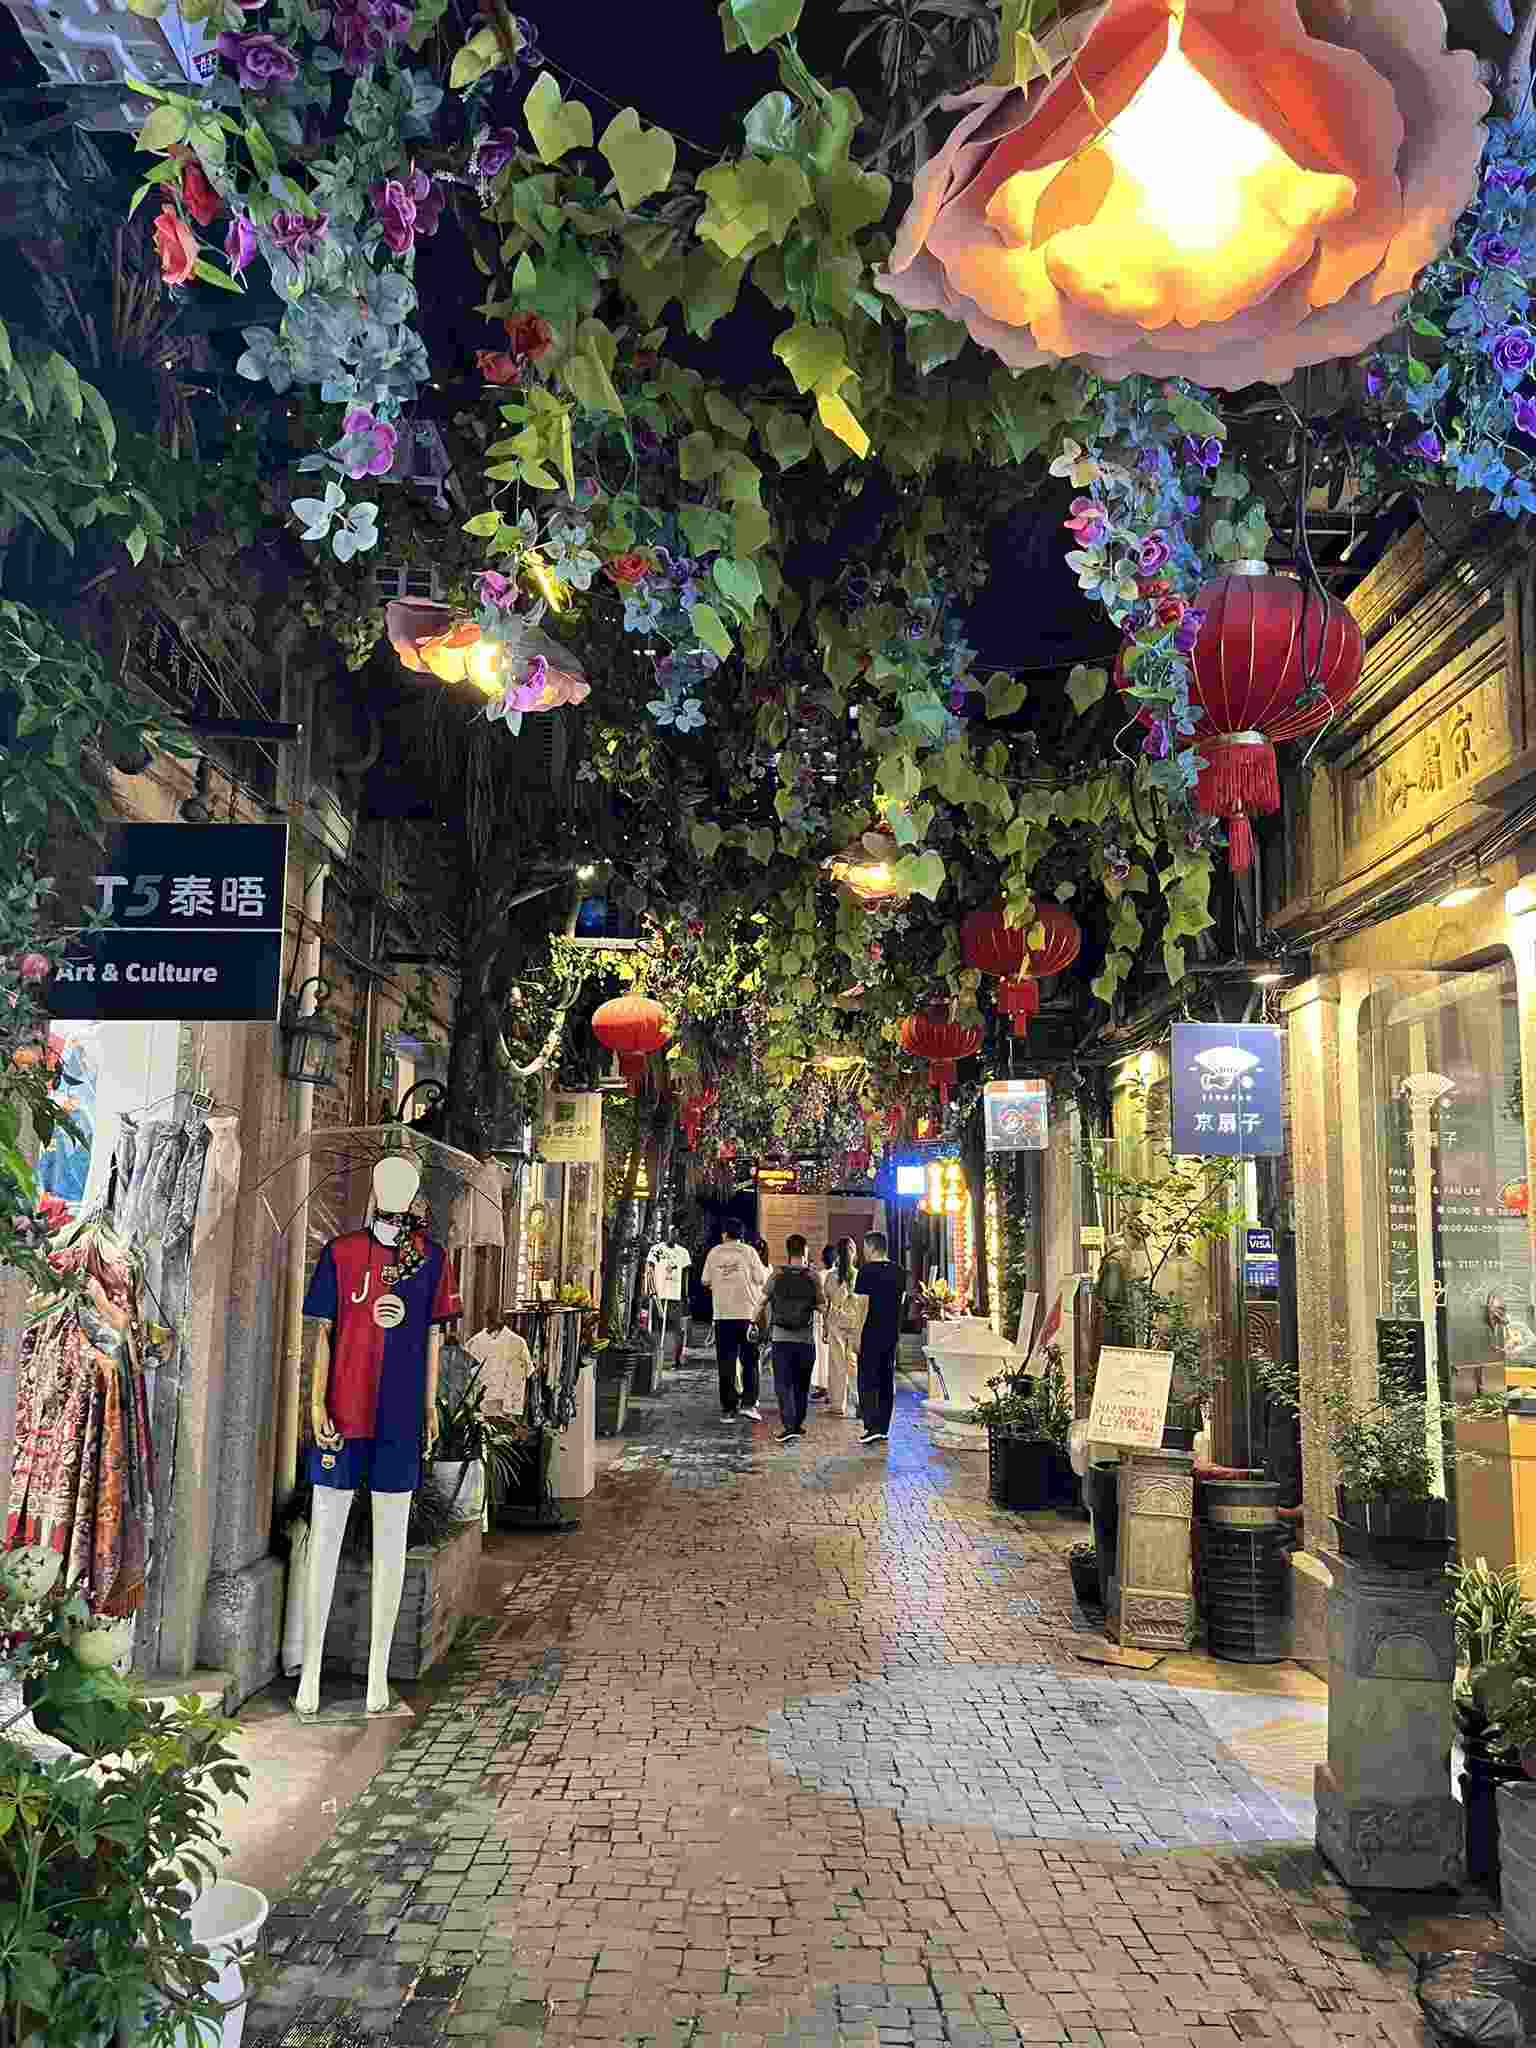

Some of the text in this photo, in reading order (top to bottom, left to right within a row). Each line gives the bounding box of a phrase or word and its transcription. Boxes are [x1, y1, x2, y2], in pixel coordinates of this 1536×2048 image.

[55, 962, 218, 982] Art & Culture
[1193, 1112, 1262, 1134] 京扇子
[1248, 1239, 1272, 1249] VISA
